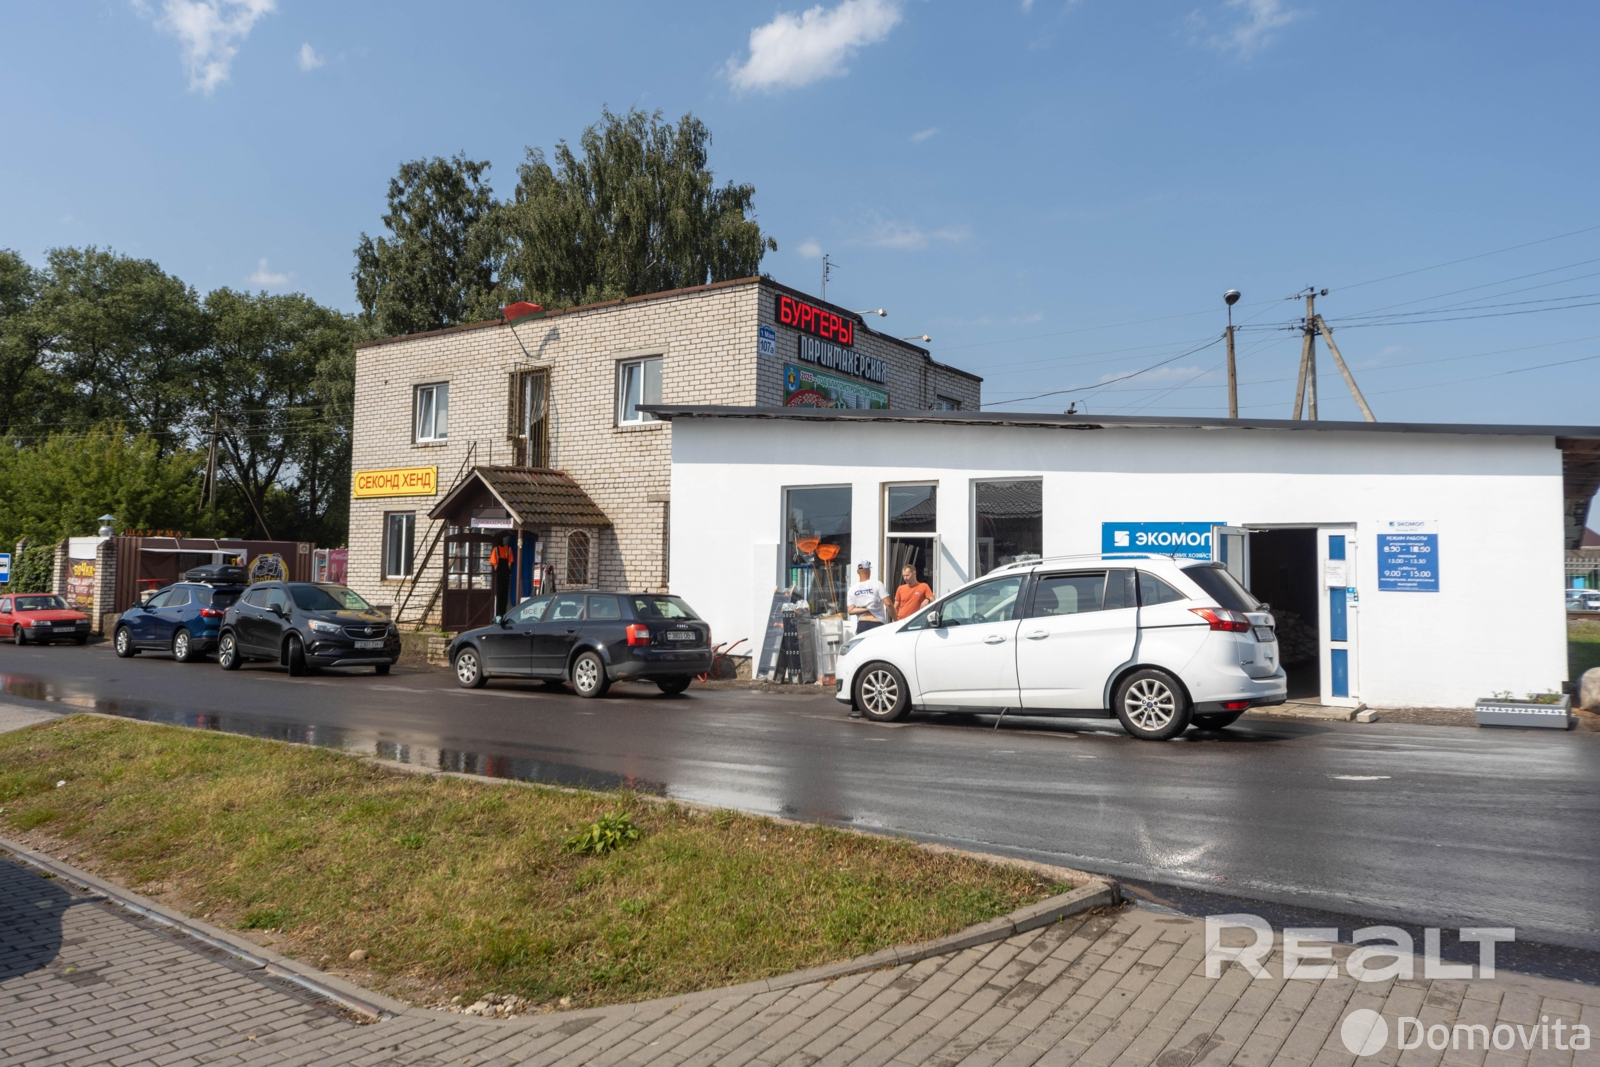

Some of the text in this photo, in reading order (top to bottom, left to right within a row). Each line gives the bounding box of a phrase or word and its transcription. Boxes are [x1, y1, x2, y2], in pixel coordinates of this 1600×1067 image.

[780, 295, 853, 345] БУРГЕРЫ
[765, 330, 775, 338] Мая
[801, 335, 886, 382] ПАРИКМАХЕРСКАЯ
[801, 370, 812, 382] 2025
[817, 375, 828, 388] ГОД
[358, 472, 431, 490] СЕКОНД ХЕНД
[126, 529, 183, 537] ШАУРМА
